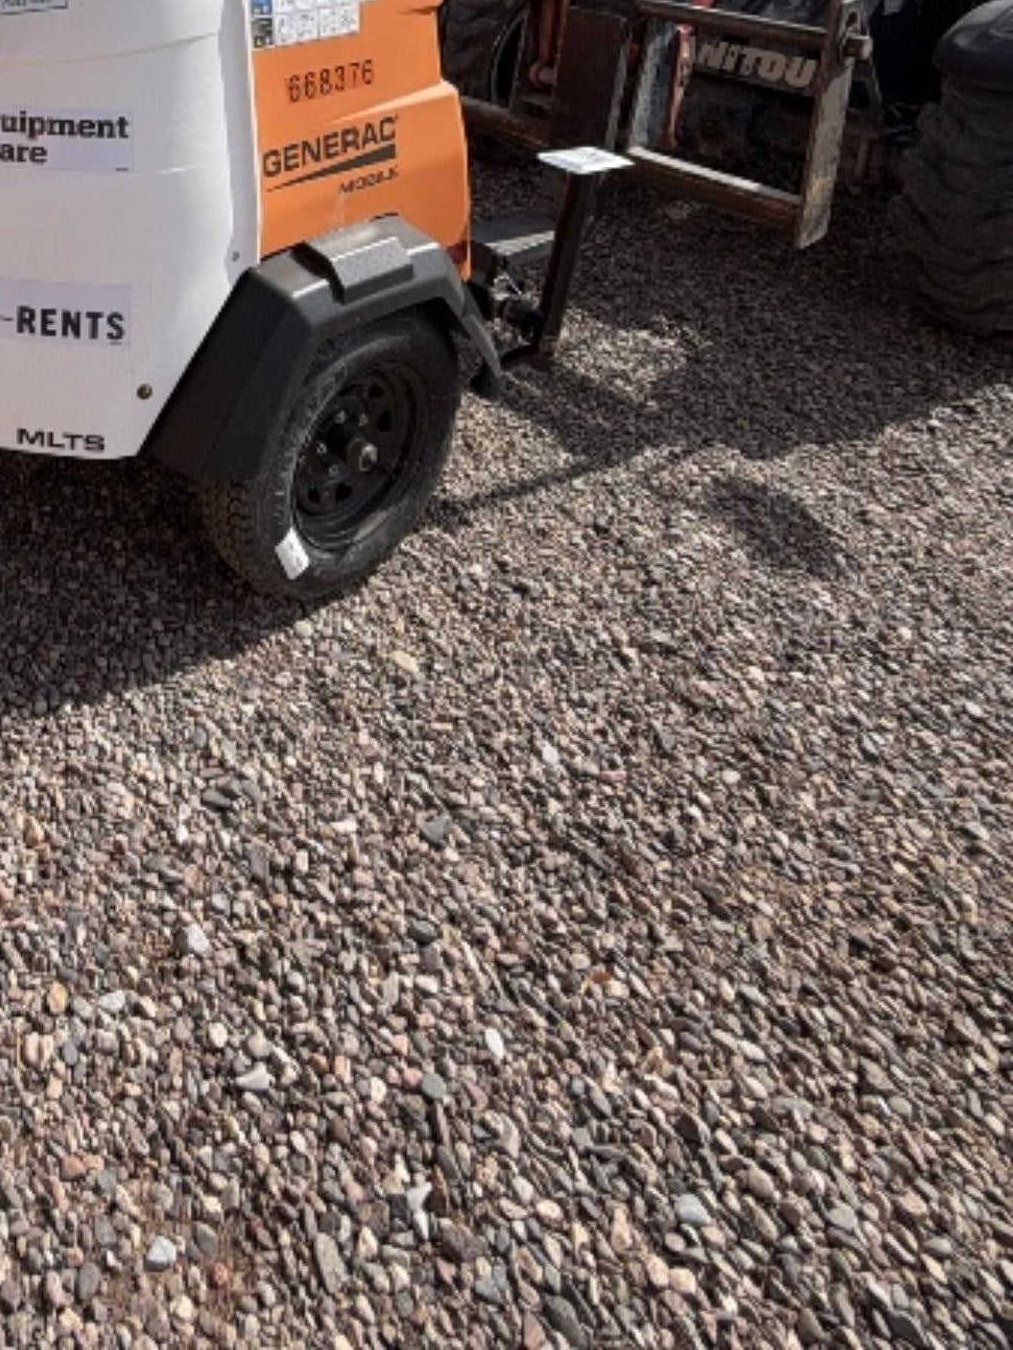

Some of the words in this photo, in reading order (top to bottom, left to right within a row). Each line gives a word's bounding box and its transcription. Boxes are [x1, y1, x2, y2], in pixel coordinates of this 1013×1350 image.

[287, 59, 374, 103] 668376
[697, 41, 817, 88] NITOU
[262, 116, 397, 178] GENERAC
[16, 428, 105, 452] MLTS
